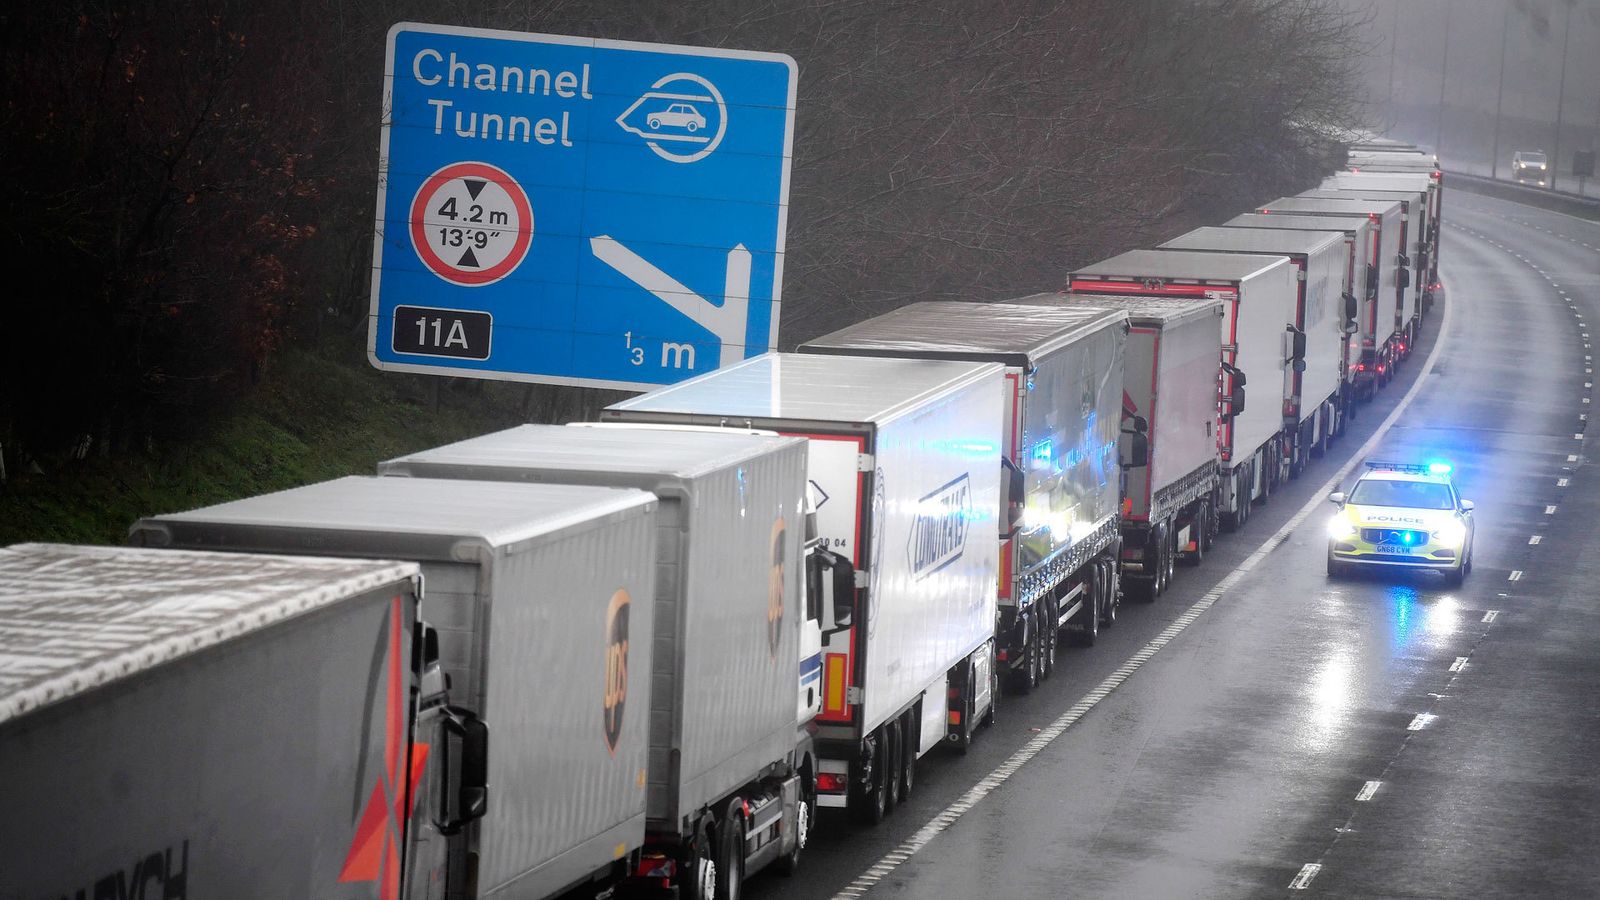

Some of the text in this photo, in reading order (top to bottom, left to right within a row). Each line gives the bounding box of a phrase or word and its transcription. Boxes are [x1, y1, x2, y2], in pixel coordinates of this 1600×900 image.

[412, 48, 593, 100] Channel
[428, 98, 573, 147] Tunnel
[438, 197, 508, 225] 4.2 m
[415, 316, 469, 349] 11A
[661, 341, 695, 370] m
[1367, 515, 1424, 524] POLICE
[834, 538, 846, 548] 04
